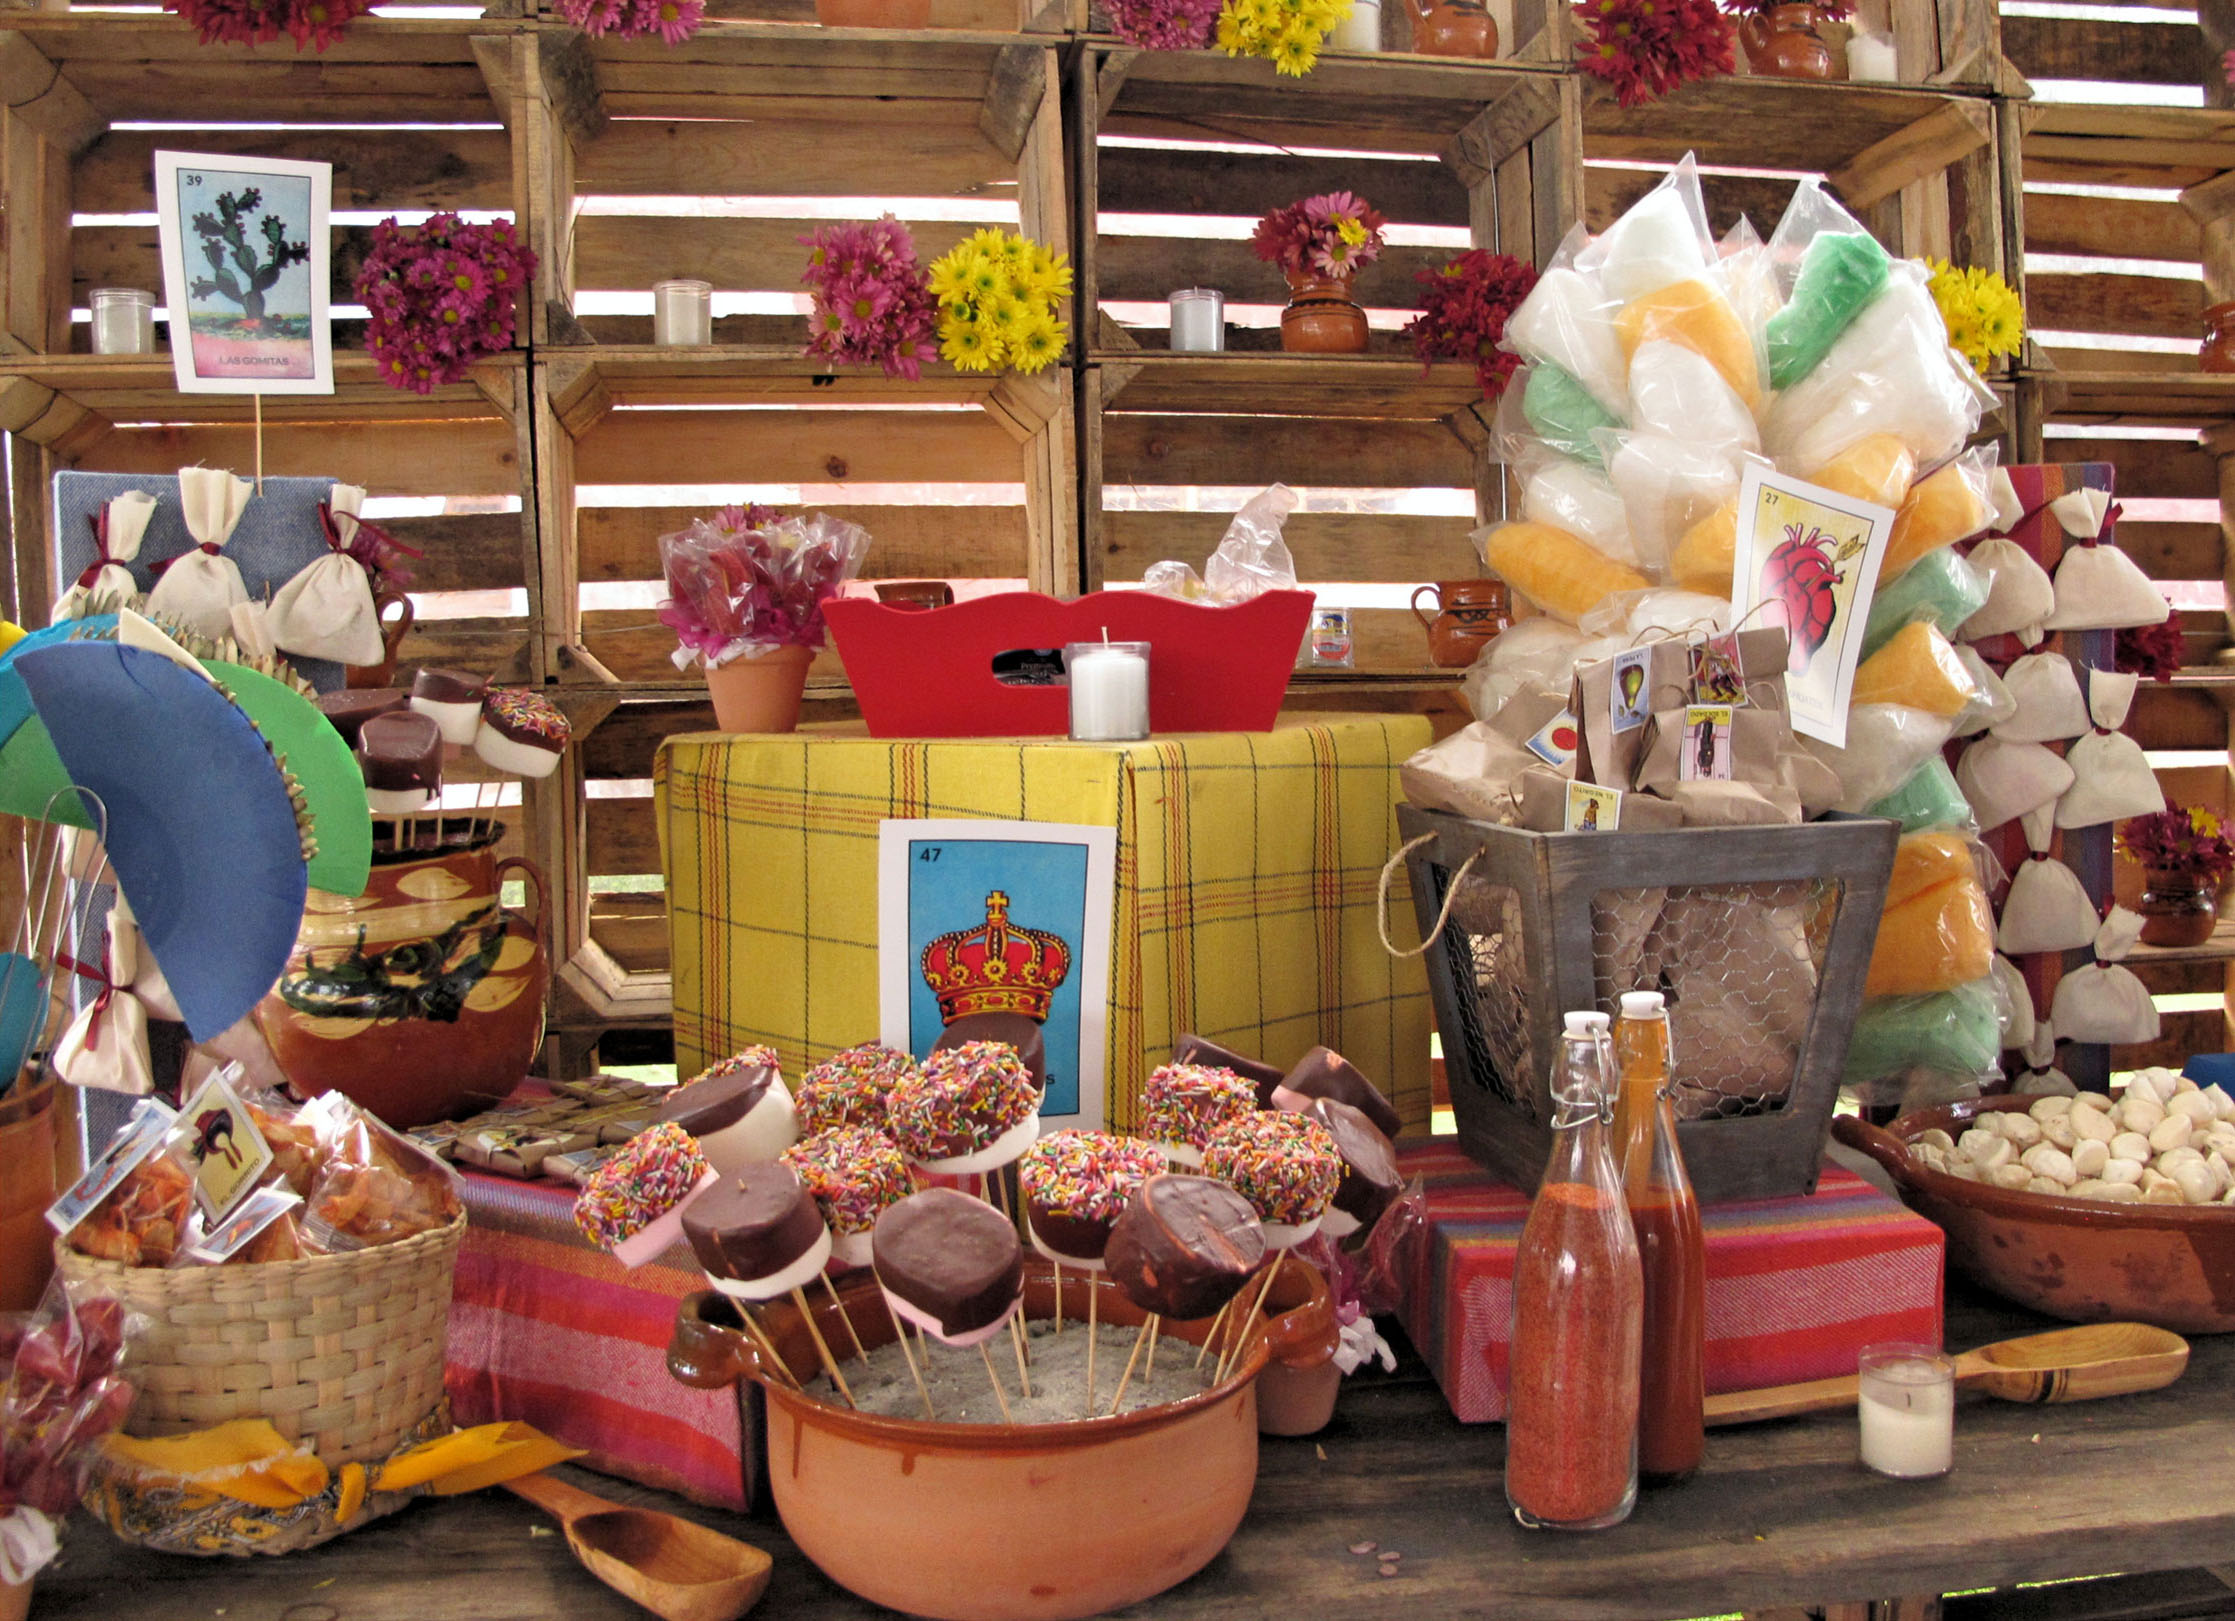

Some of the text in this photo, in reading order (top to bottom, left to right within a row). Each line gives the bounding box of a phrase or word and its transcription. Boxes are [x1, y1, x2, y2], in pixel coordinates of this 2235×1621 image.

[187, 175, 202, 187] 39
[1766, 492, 1779, 505] 27
[920, 848, 941, 862] 47
